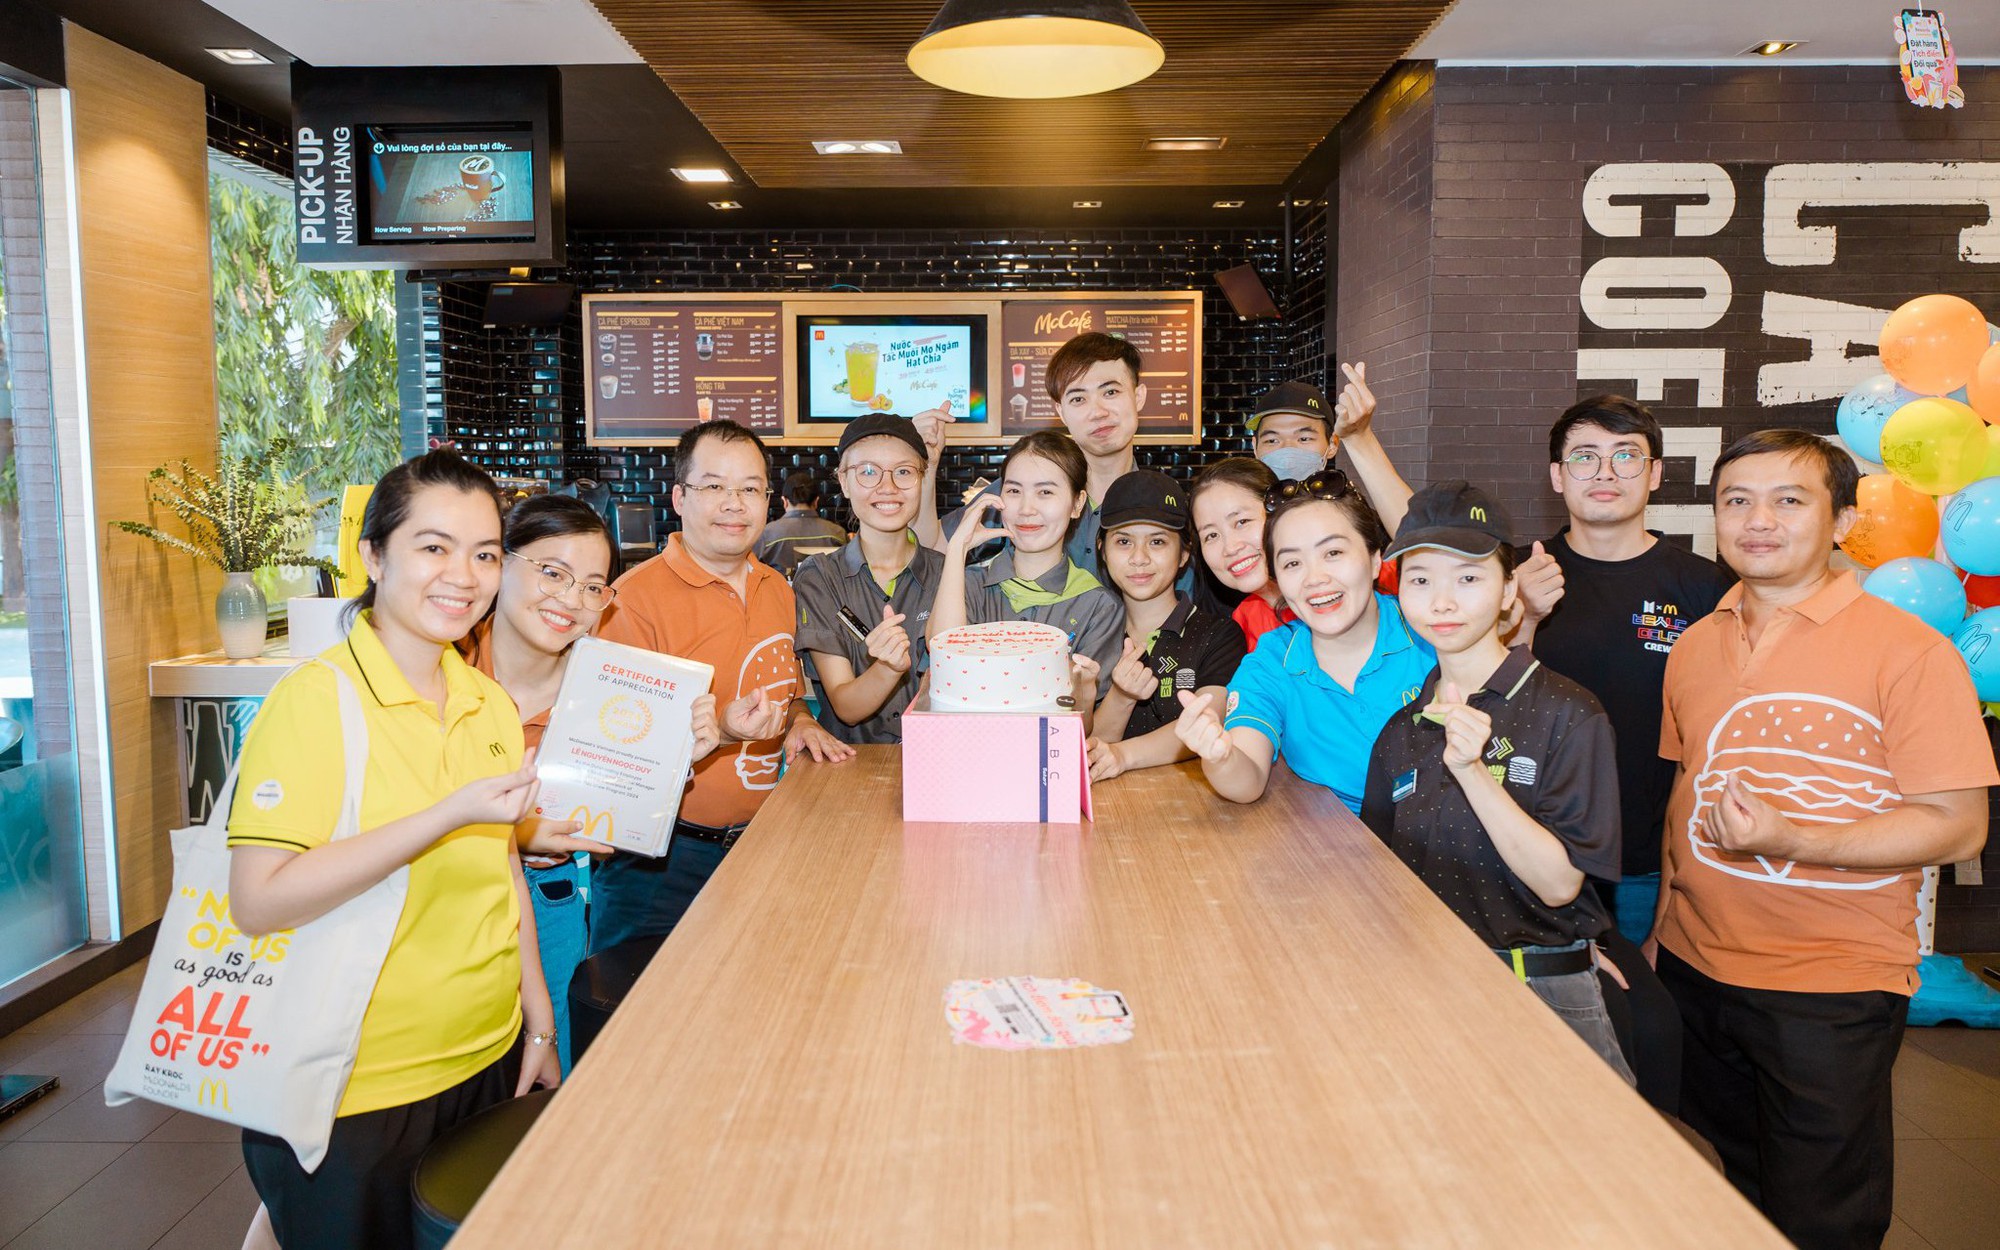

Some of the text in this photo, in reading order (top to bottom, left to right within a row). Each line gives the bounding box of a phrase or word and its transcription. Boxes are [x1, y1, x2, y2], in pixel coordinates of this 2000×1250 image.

[331, 126, 351, 183] HÀNG
[298, 127, 327, 244] PICK-UP
[389, 226, 412, 234] Serving
[620, 317, 651, 326] ESPRESSO
[731, 317, 744, 326] NAM
[1033, 310, 1093, 335] McCafé
[1644, 642, 1672, 653] CREW
[598, 674, 674, 700] OF APPRECIATION
[602, 663, 677, 691] CERTIFICATE
[187, 921, 242, 954] OF
[225, 951, 245, 966] IS
[174, 957, 274, 988] as good as
[156, 985, 253, 1039] ALL
[150, 1028, 194, 1062] OF
[145, 1063, 183, 1080] RAY KROC
